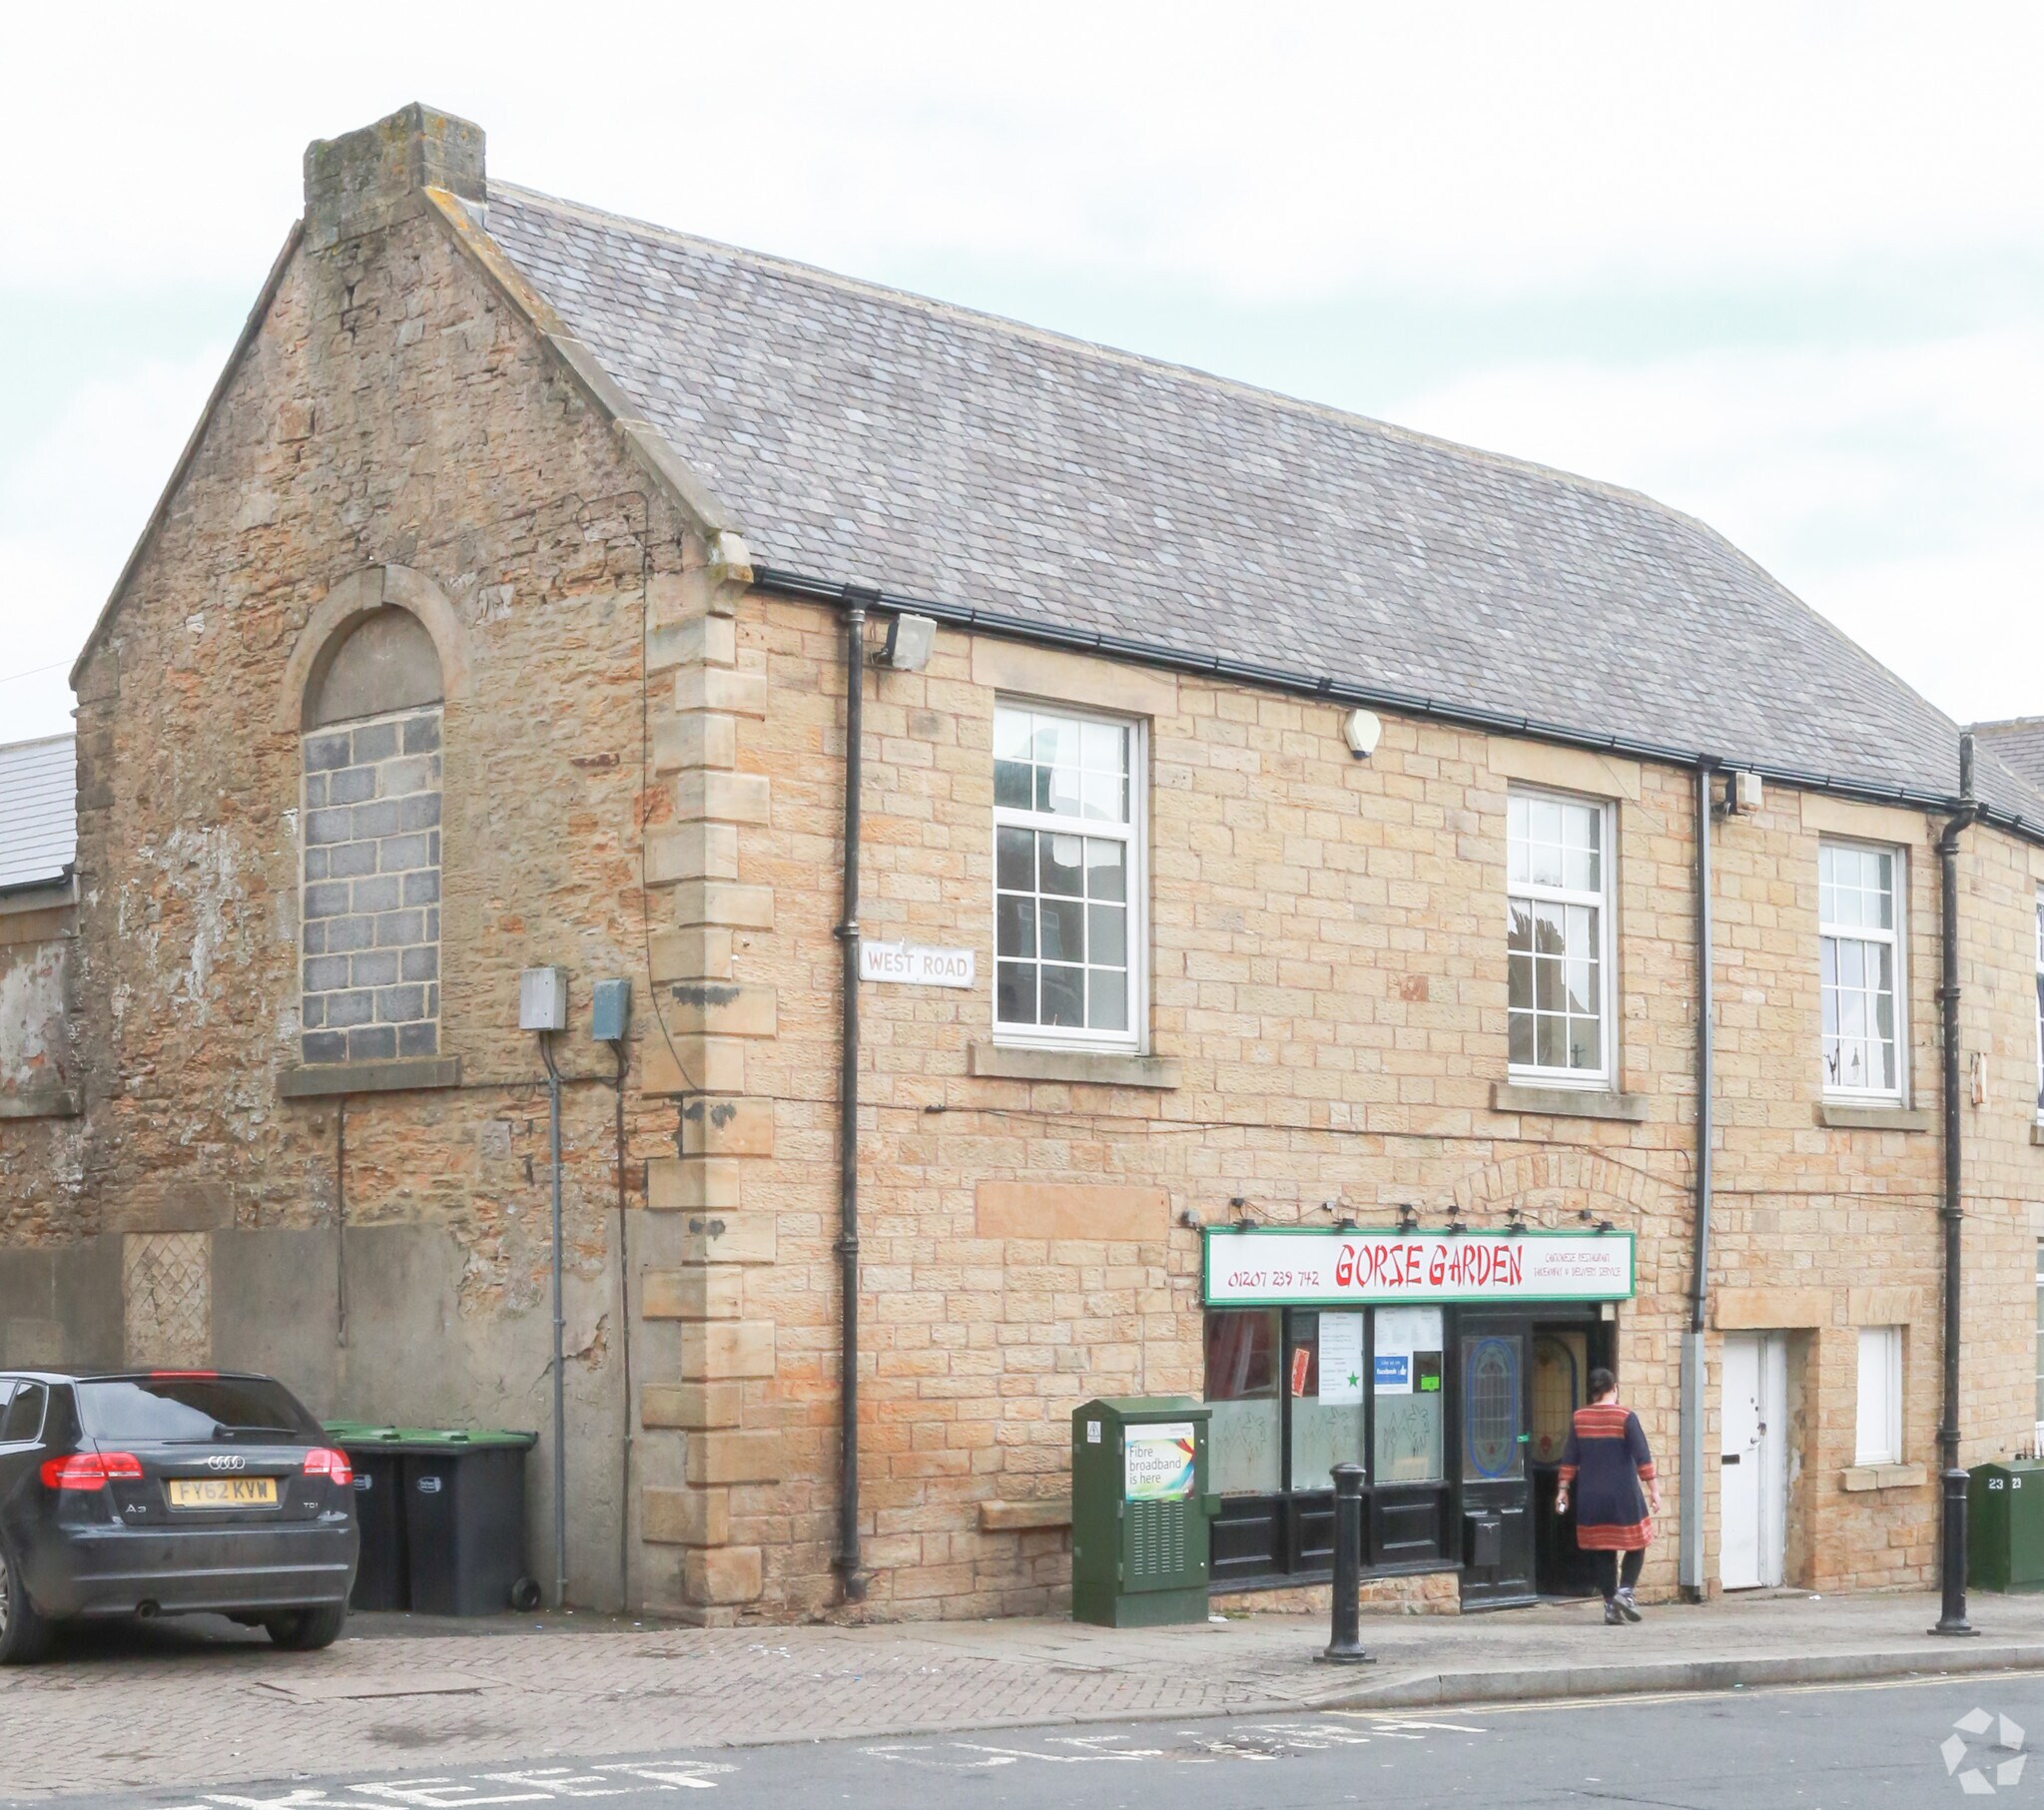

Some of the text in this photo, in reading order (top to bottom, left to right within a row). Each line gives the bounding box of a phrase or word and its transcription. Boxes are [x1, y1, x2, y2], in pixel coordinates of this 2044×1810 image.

[868, 950, 968, 977] WEST ROAD
[1335, 1244, 1524, 1288] GORSE GARDEN
[1598, 1266, 1622, 1277] SERVICE
[1227, 1270, 1320, 1287] 01207 239 742
[1129, 1445, 1153, 1458] Fibre
[1129, 1457, 1181, 1472] broadband
[1129, 1472, 1161, 1485] is here
[1988, 1479, 2004, 1490] 23
[2012, 1478, 2022, 1490] 23
[179, 1481, 269, 1501] FY62 KVW
[125, 1503, 147, 1513] A3
[198, 1759, 741, 1810] KEEP
